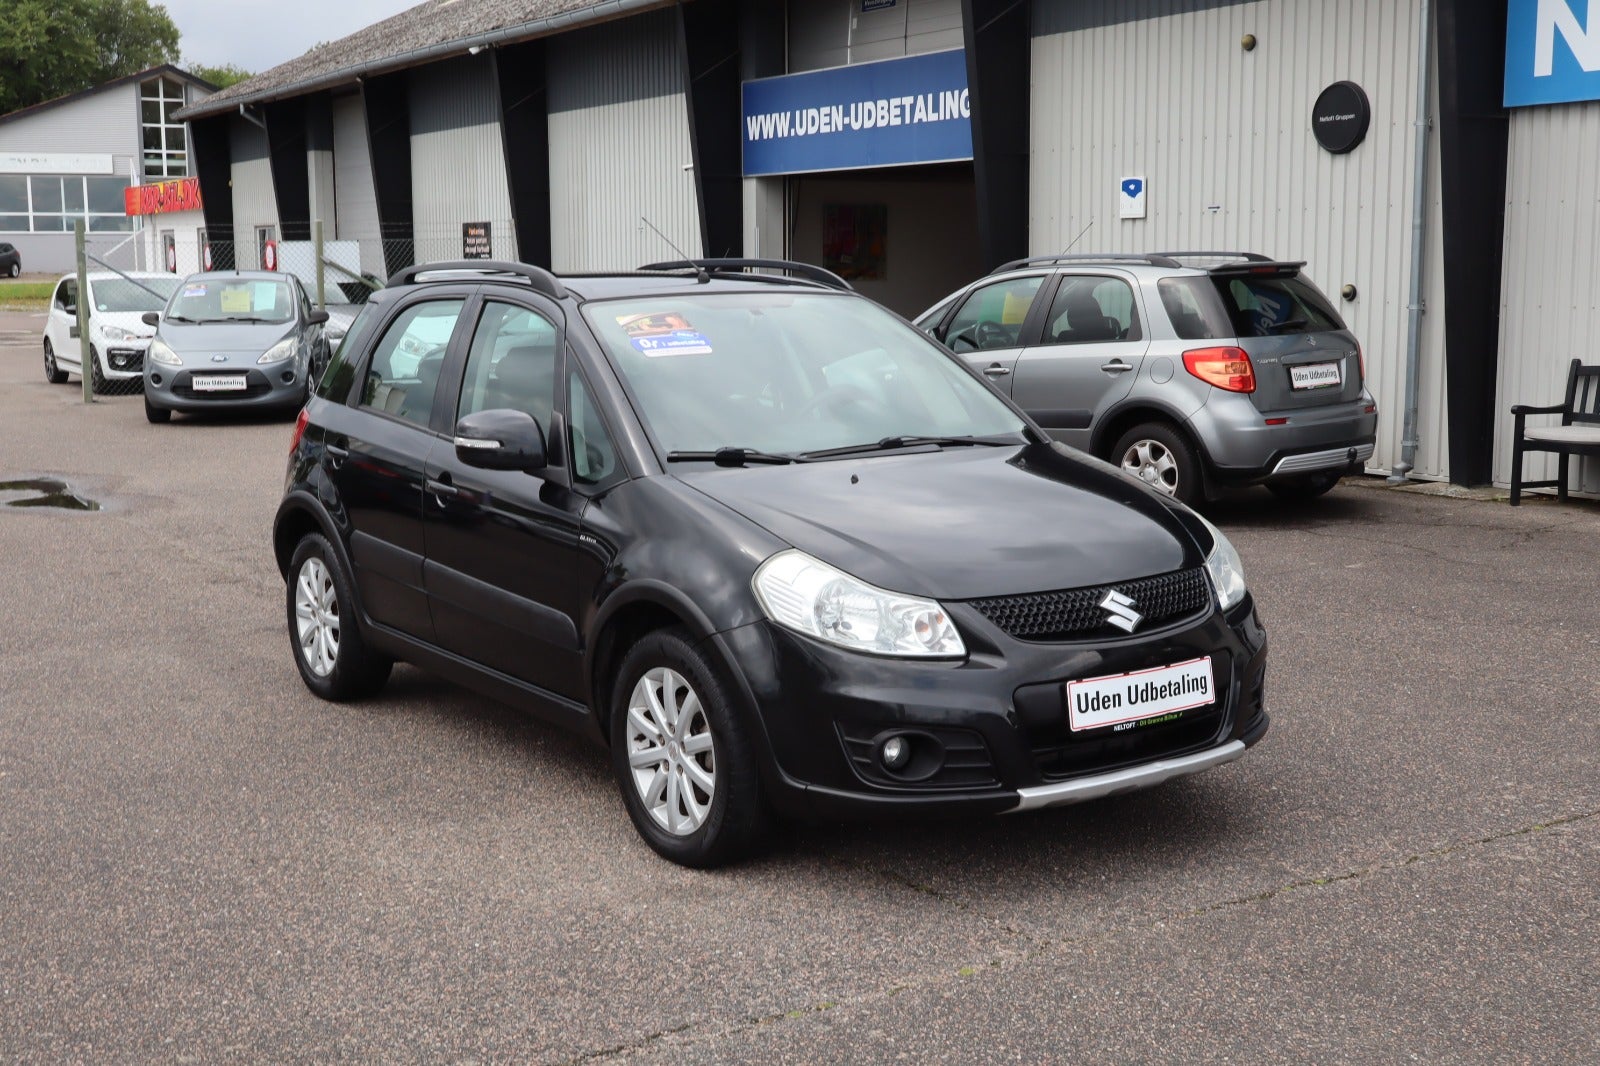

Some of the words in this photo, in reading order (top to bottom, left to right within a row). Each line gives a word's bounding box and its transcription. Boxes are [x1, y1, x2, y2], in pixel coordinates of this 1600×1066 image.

[1293, 372, 1309, 382] Uden
[1309, 369, 1338, 380] Udbetaling
[1076, 691, 1122, 714] Uden
[1127, 673, 1208, 706] Udbetaling
[1113, 721, 1136, 732] NELTOFT
